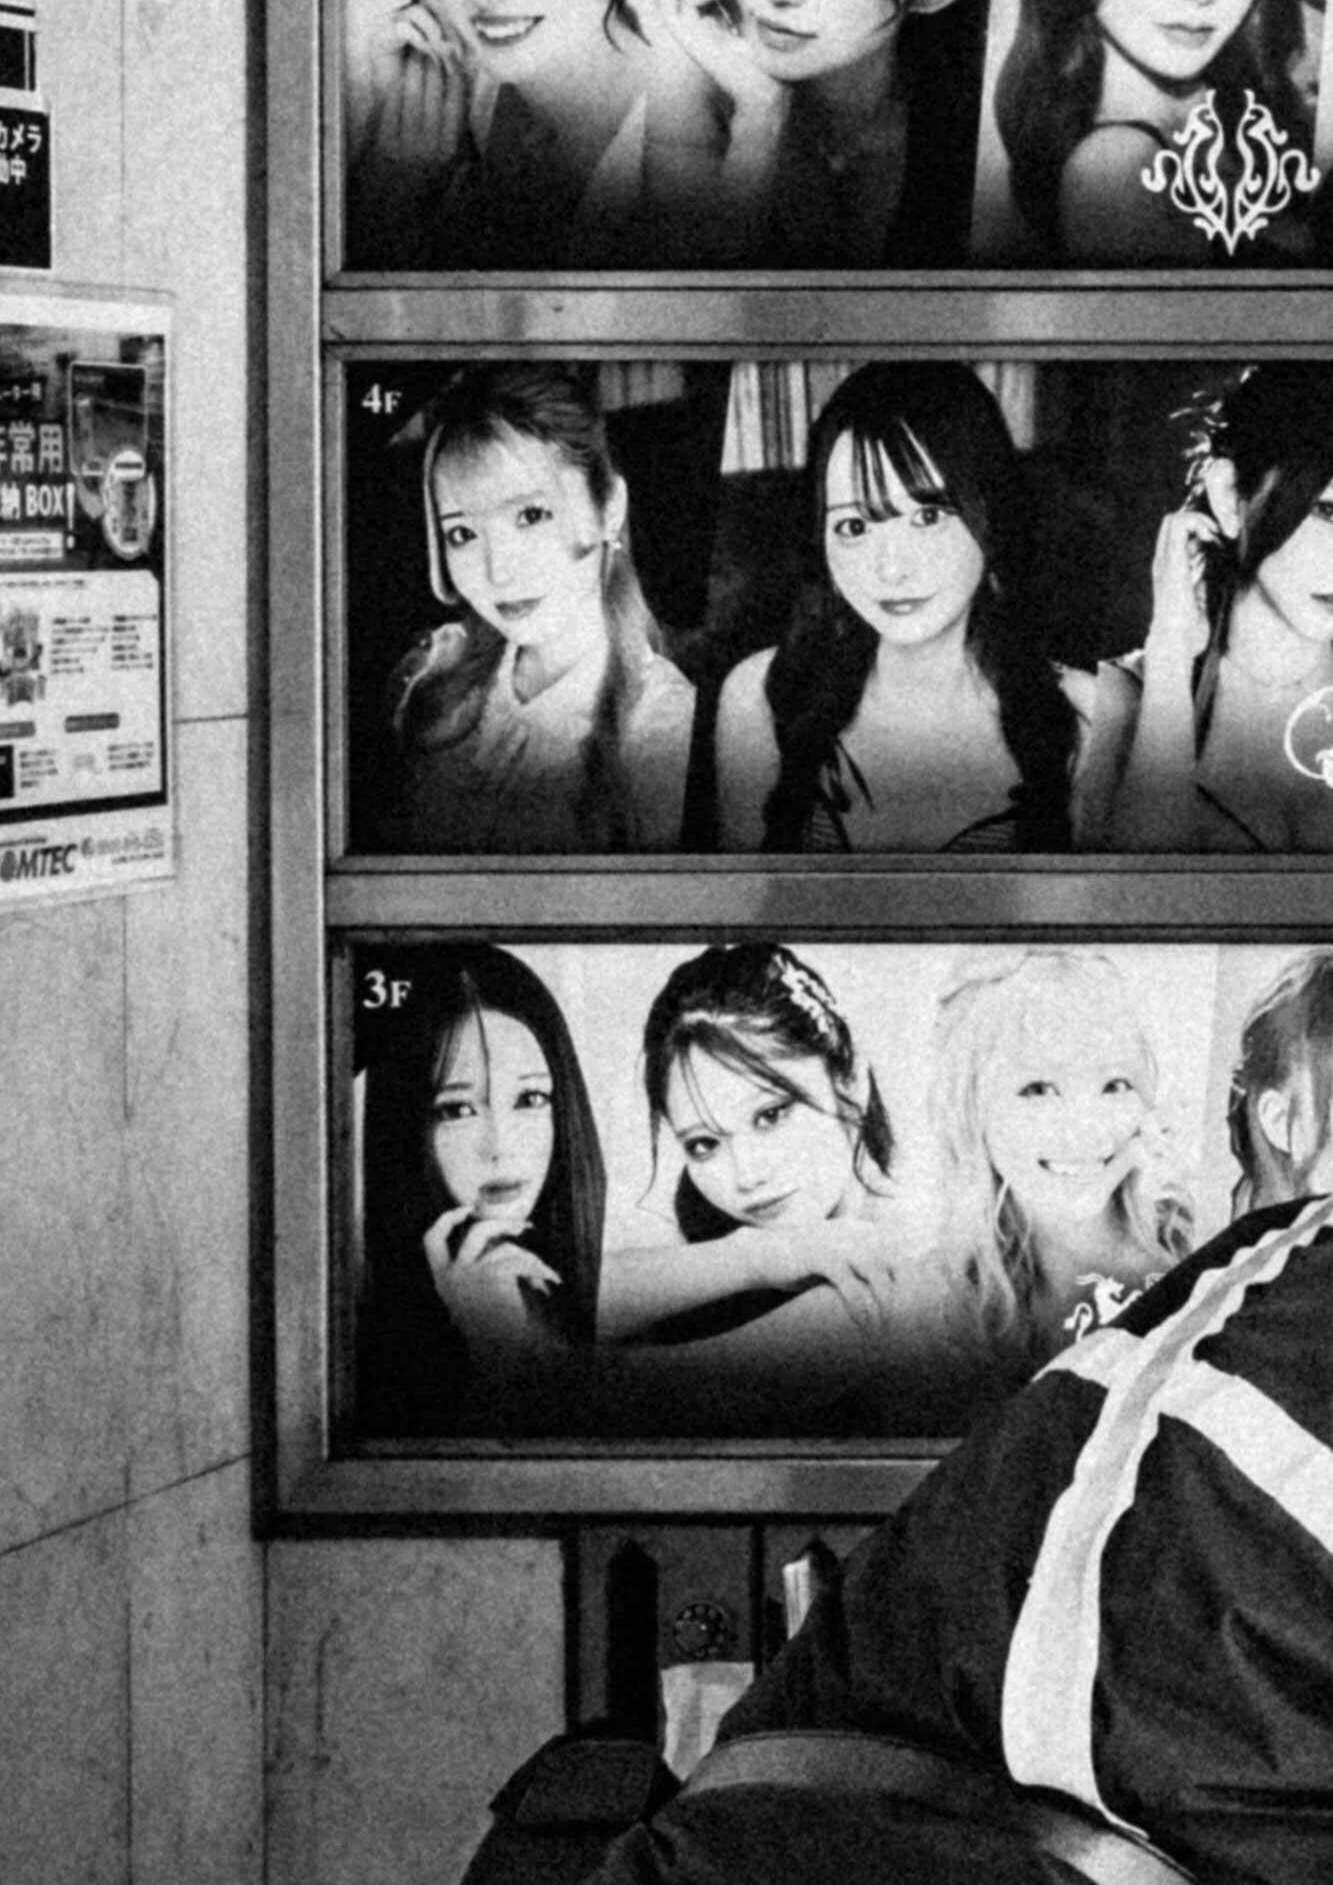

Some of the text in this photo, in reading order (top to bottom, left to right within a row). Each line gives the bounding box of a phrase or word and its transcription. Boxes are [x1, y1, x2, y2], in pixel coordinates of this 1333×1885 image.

[361, 383, 403, 414] 4F
[0, 419, 63, 474] 常用
[363, 970, 412, 1009] 3F
